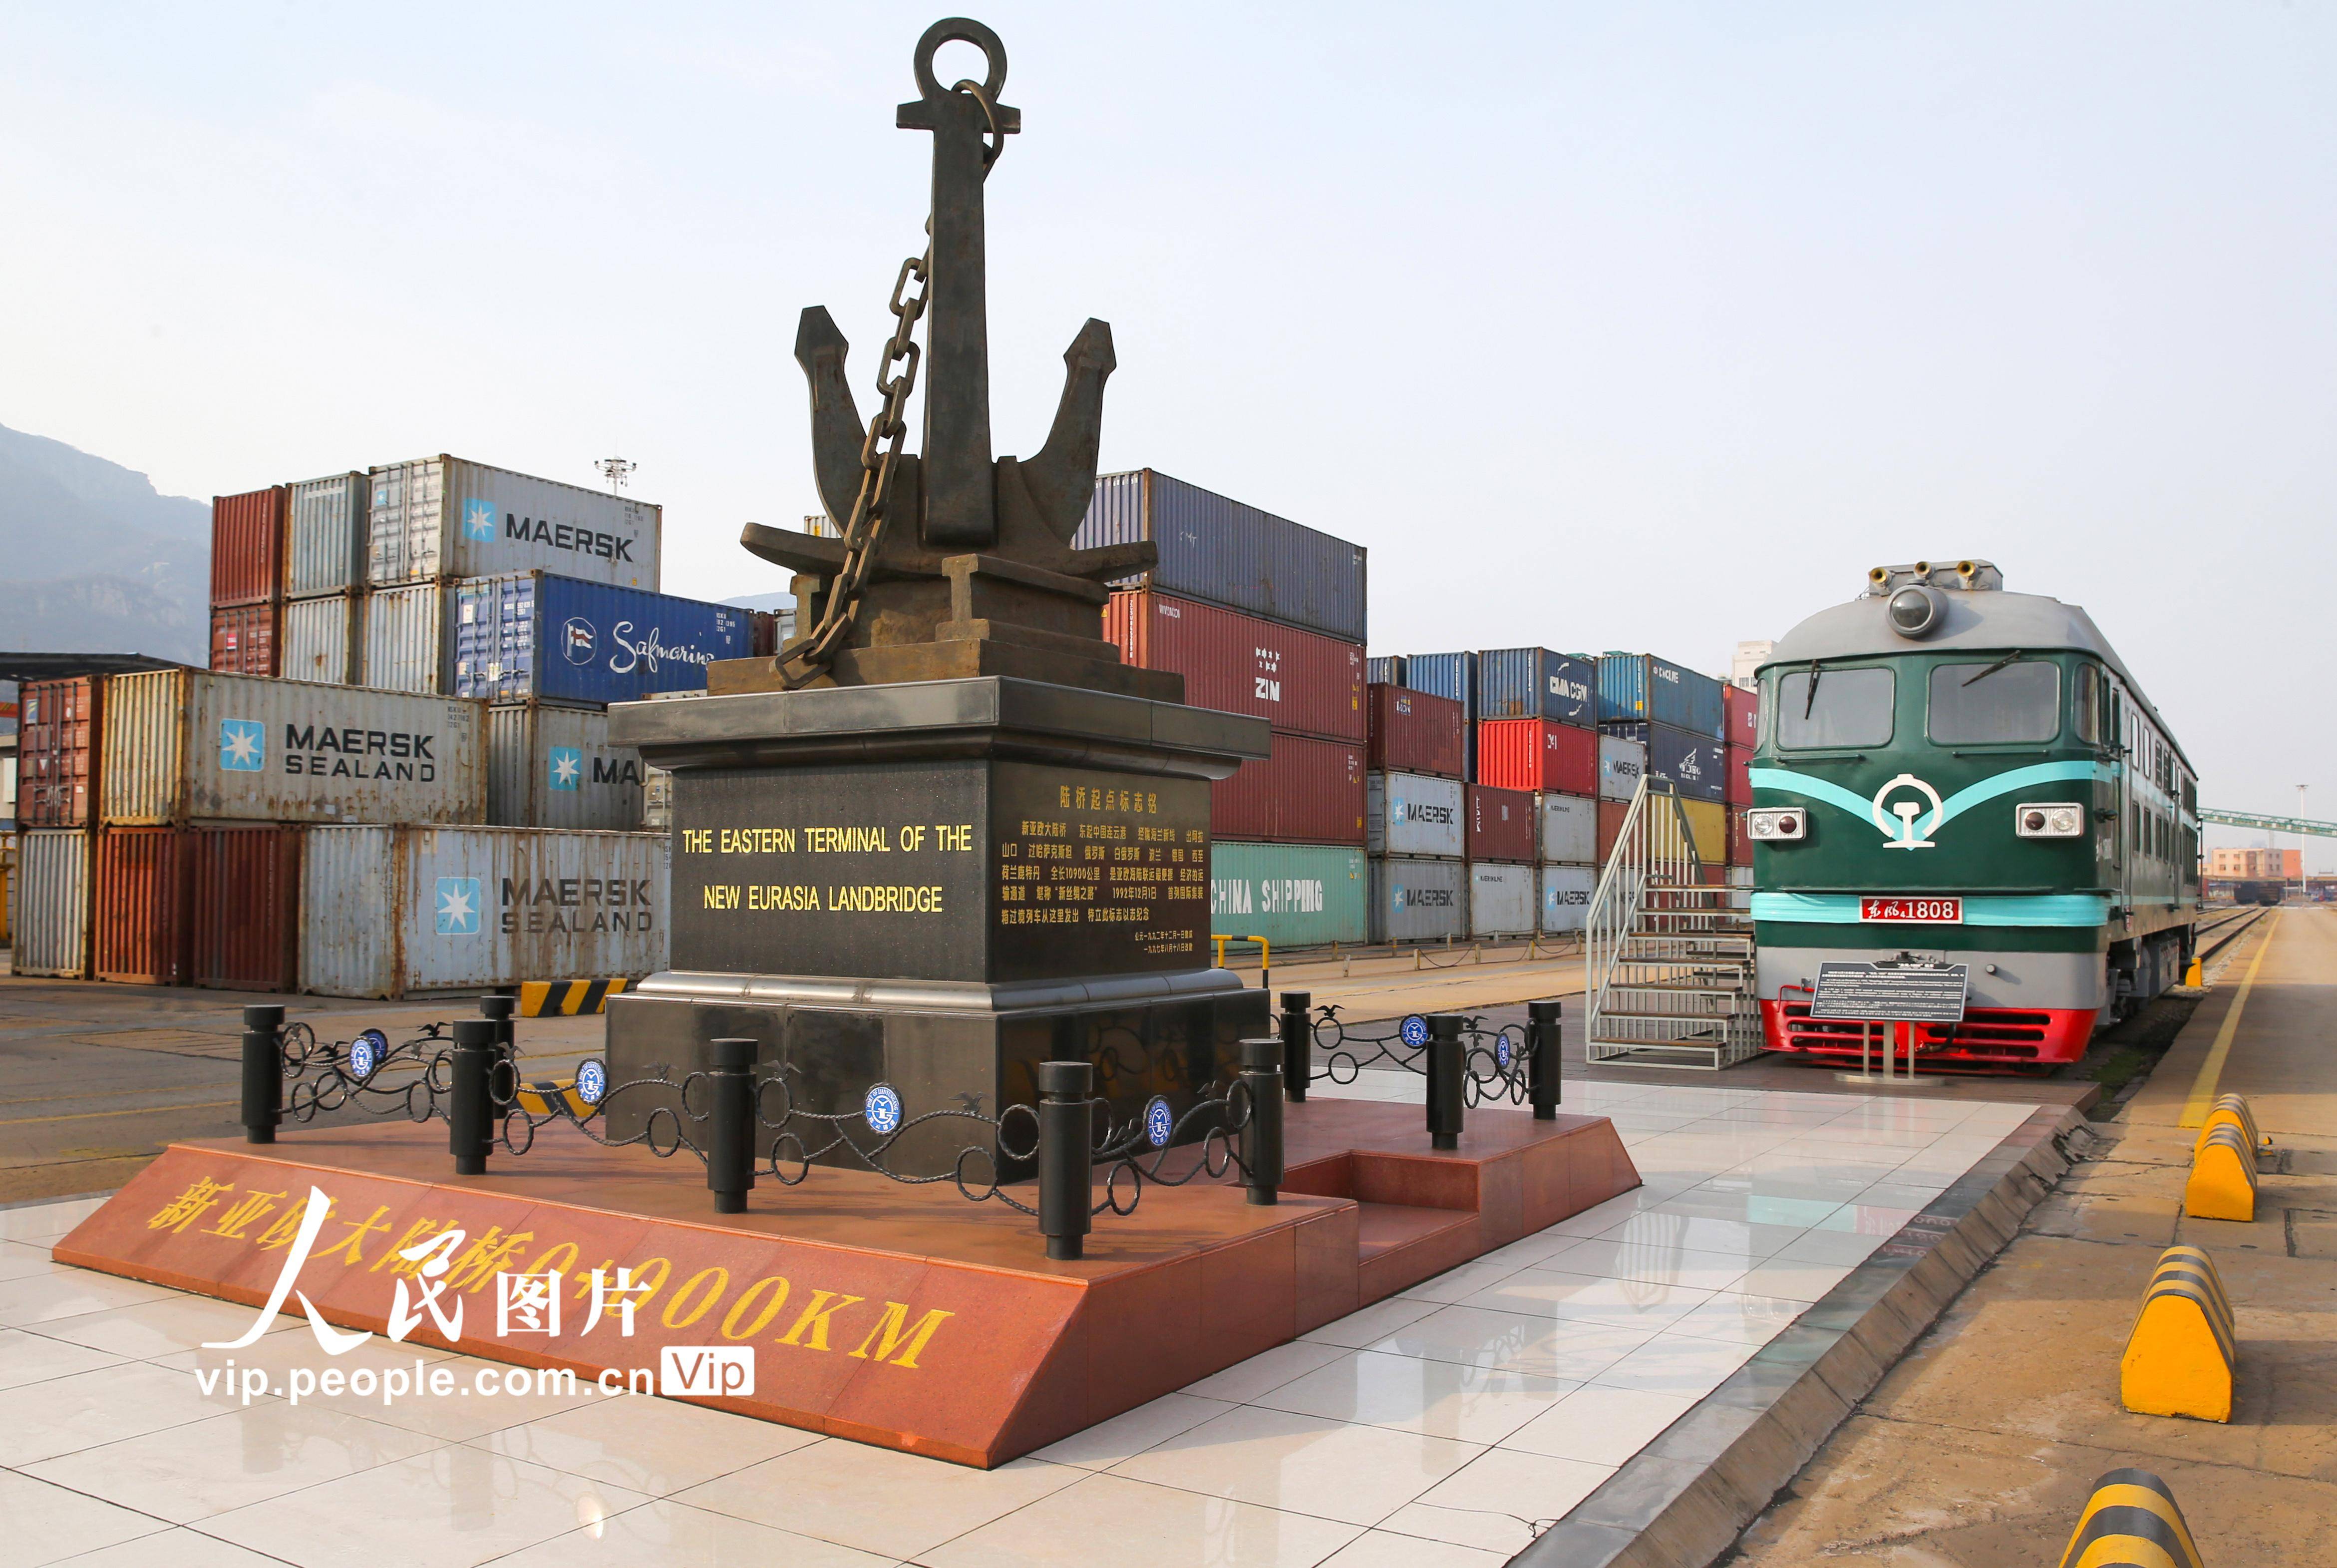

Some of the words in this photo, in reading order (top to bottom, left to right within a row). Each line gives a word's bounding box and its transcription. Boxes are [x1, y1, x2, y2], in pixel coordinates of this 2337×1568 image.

[506, 513, 634, 562] MAERSK
[1570, 682, 1587, 703] CGM
[286, 724, 434, 759] MAERSK
[286, 754, 435, 783] SEALAND
[1060, 785, 1157, 814] 陆桥起点标志铭
[1408, 803, 1454, 825] MAERSK
[682, 829, 712, 854] THE
[720, 828, 796, 854] EASTERN
[804, 827, 891, 853] TERMINAL
[900, 825, 925, 852] OF
[936, 824, 973, 851] THE
[1022, 820, 1066, 837] 新亚欧大陆桥
[1079, 824, 1126, 840] 东起中国连云港
[1002, 842, 1017, 858] 山口
[1028, 843, 1072, 859] 过哈萨克斯坦
[1085, 846, 1105, 860] 俄罗斯
[1115, 847, 1140, 861] 白俄罗斯
[1149, 848, 1161, 862] 波兰
[1172, 849, 1184, 862] 德国
[1192, 850, 1203, 862] 西至
[1002, 865, 1040, 880] 荷兰鹿特丹
[1051, 866, 1100, 881] 全长10900公里
[501, 878, 652, 906] MAERSK
[704, 885, 740, 909] NEW
[748, 886, 820, 911] EURASIA
[829, 886, 943, 913] LANDBRIDGE
[1112, 886, 1156, 900] 1992年12月1日
[1211, 880, 1252, 914] CHINA
[1262, 880, 1323, 913] SHIPPING
[1406, 889, 1454, 907] MAERSK
[501, 912, 653, 935] SEALAND
[1002, 908, 1079, 925] 箱过境列车从这里发出
[1088, 907, 1149, 923] 特立此标志以志纪念
